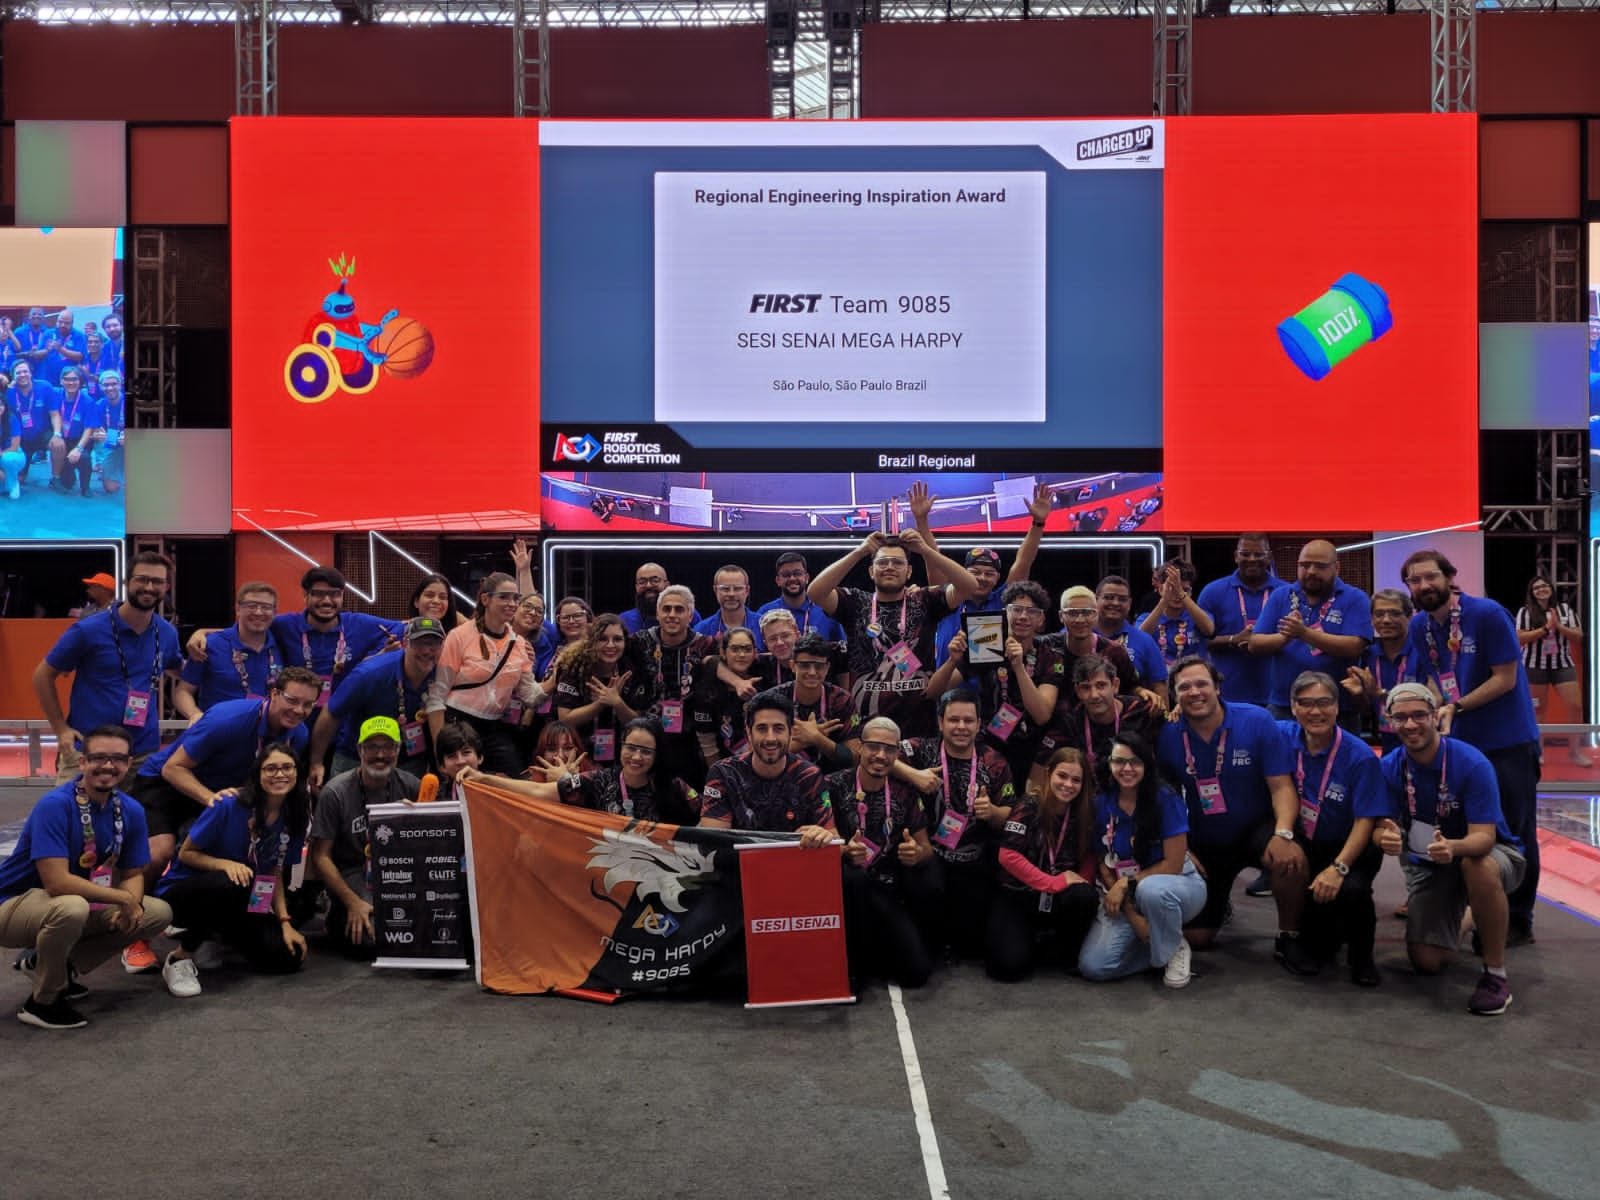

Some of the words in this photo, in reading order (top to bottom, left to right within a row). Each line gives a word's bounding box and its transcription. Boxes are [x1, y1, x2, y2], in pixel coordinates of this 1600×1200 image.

[1080, 132, 1134, 158] CHARGED
[1135, 128, 1152, 147] UP
[694, 189, 764, 206] Regional
[768, 189, 862, 206] Engineering
[867, 189, 951, 206] Inspiration
[955, 188, 1006, 203] Award
[750, 294, 822, 313] FIRST
[830, 295, 888, 313] Team
[898, 295, 951, 313] 9085
[1317, 305, 1361, 346] 100%
[737, 332, 776, 348] SESI
[781, 332, 836, 348] SENAI
[841, 332, 895, 348] MEGA
[900, 332, 963, 348] HARPY
[773, 379, 795, 391] São
[798, 380, 833, 392] Paulo,
[835, 379, 857, 391] São
[860, 380, 893, 391] Paulo
[896, 380, 927, 391] Brazil
[603, 432, 638, 443] FIRST
[603, 443, 661, 454] ROBOTICS
[603, 454, 681, 465] COMPETITION
[878, 454, 915, 467] Brazil
[918, 454, 975, 470] Regional
[865, 682, 888, 690] SESI
[1232, 758, 1251, 767] FRC
[399, 828, 457, 839] sponsors
[388, 857, 414, 865] BOSCH
[754, 919, 787, 932] SESI
[794, 915, 838, 929] SENAI
[631, 963, 691, 982] #9085
